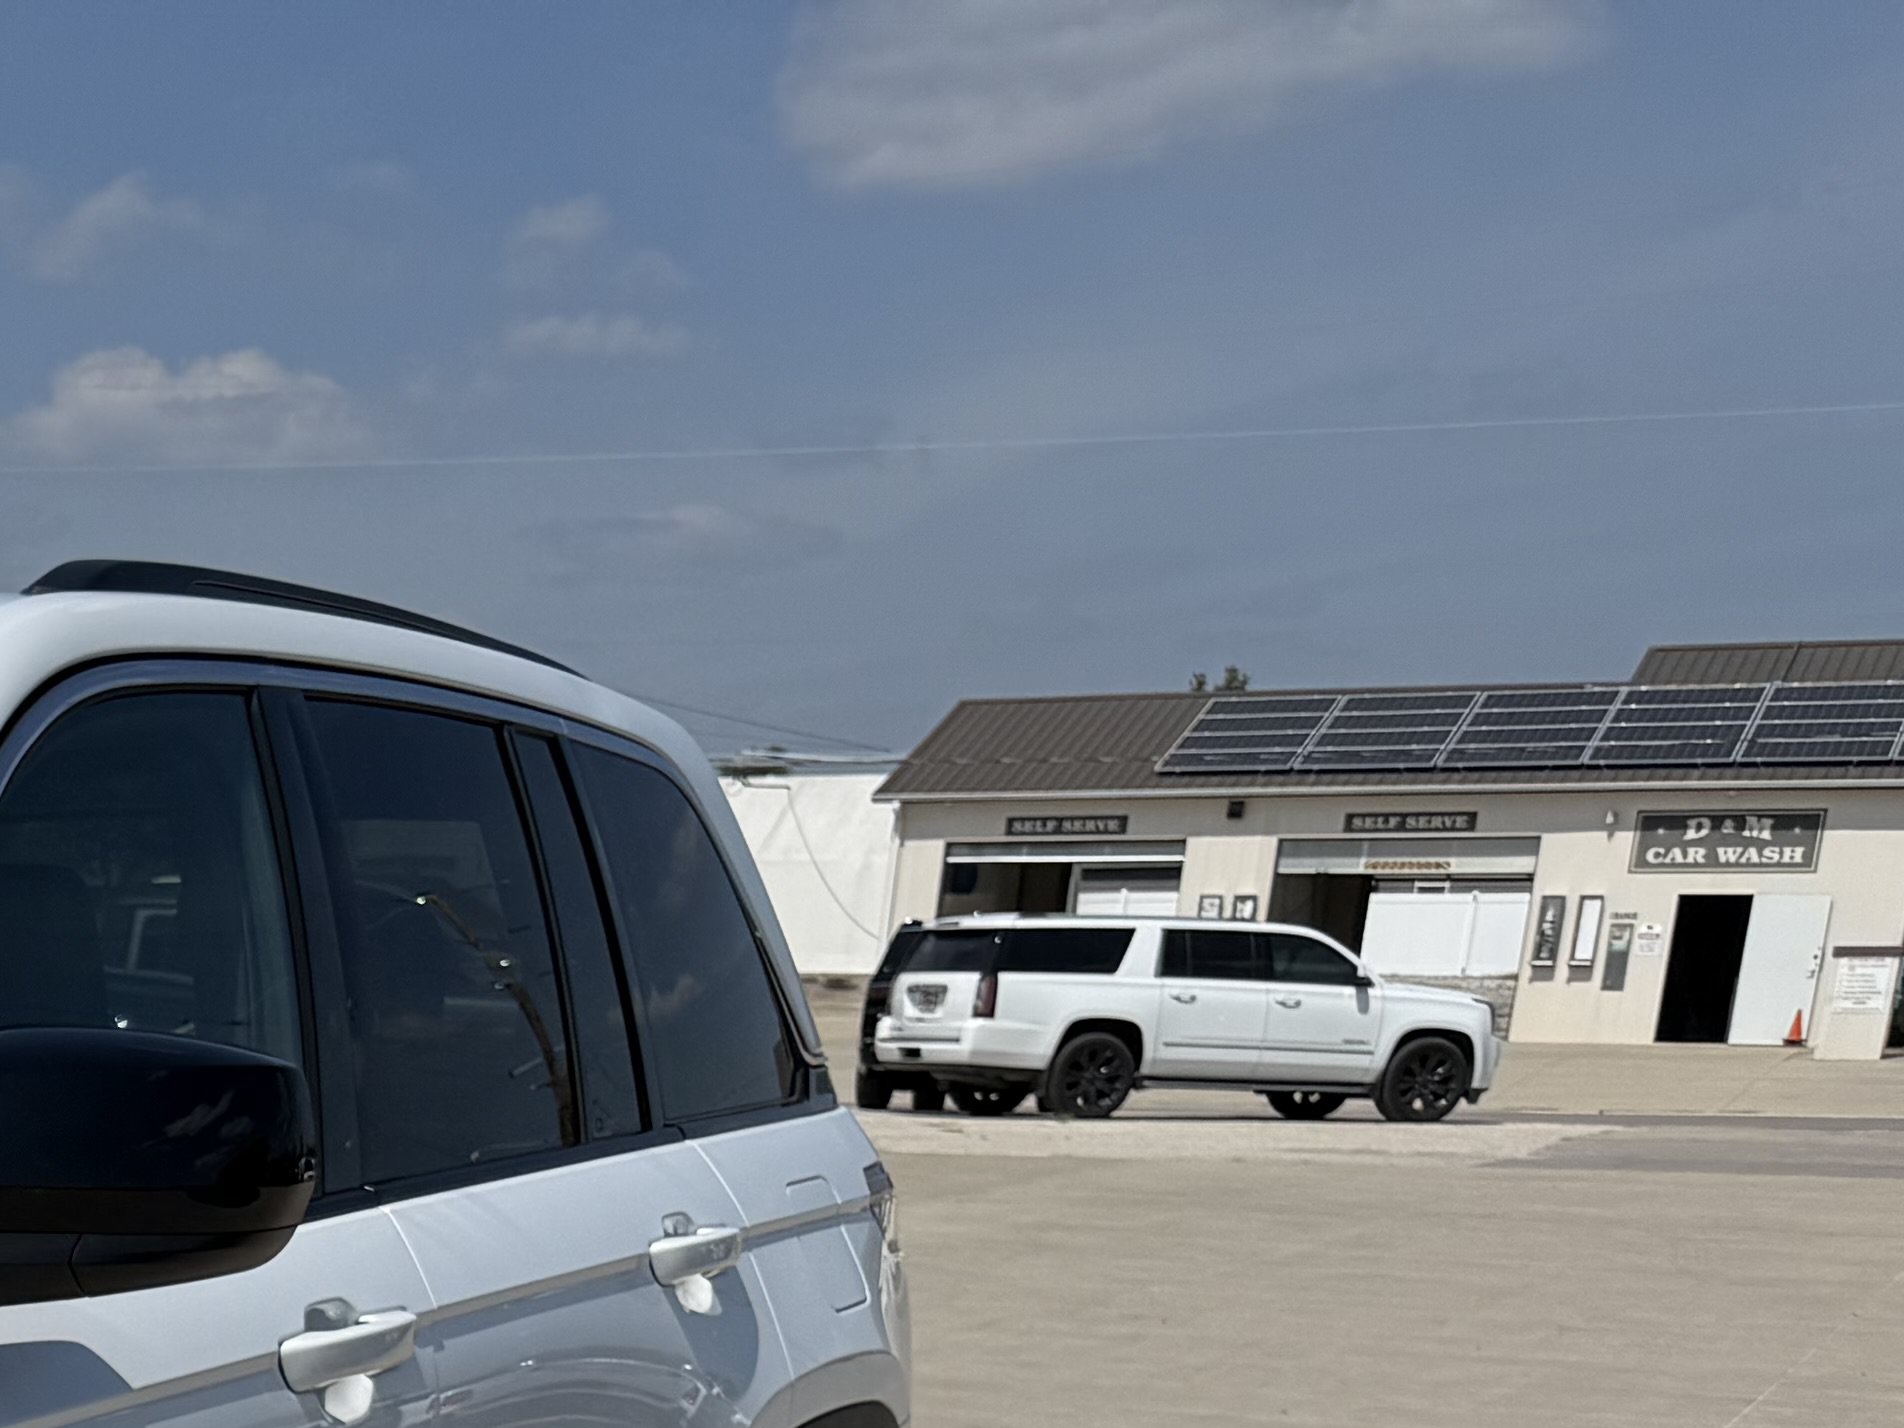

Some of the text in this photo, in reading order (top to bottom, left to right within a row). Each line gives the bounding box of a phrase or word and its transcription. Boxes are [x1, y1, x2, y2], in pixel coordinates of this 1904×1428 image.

[1011, 818, 1120, 833] SELF SERVE
[1351, 815, 1469, 830] SELF SERVE
[1683, 815, 1775, 840] D & M
[1645, 846, 1806, 864] CAR WASH
